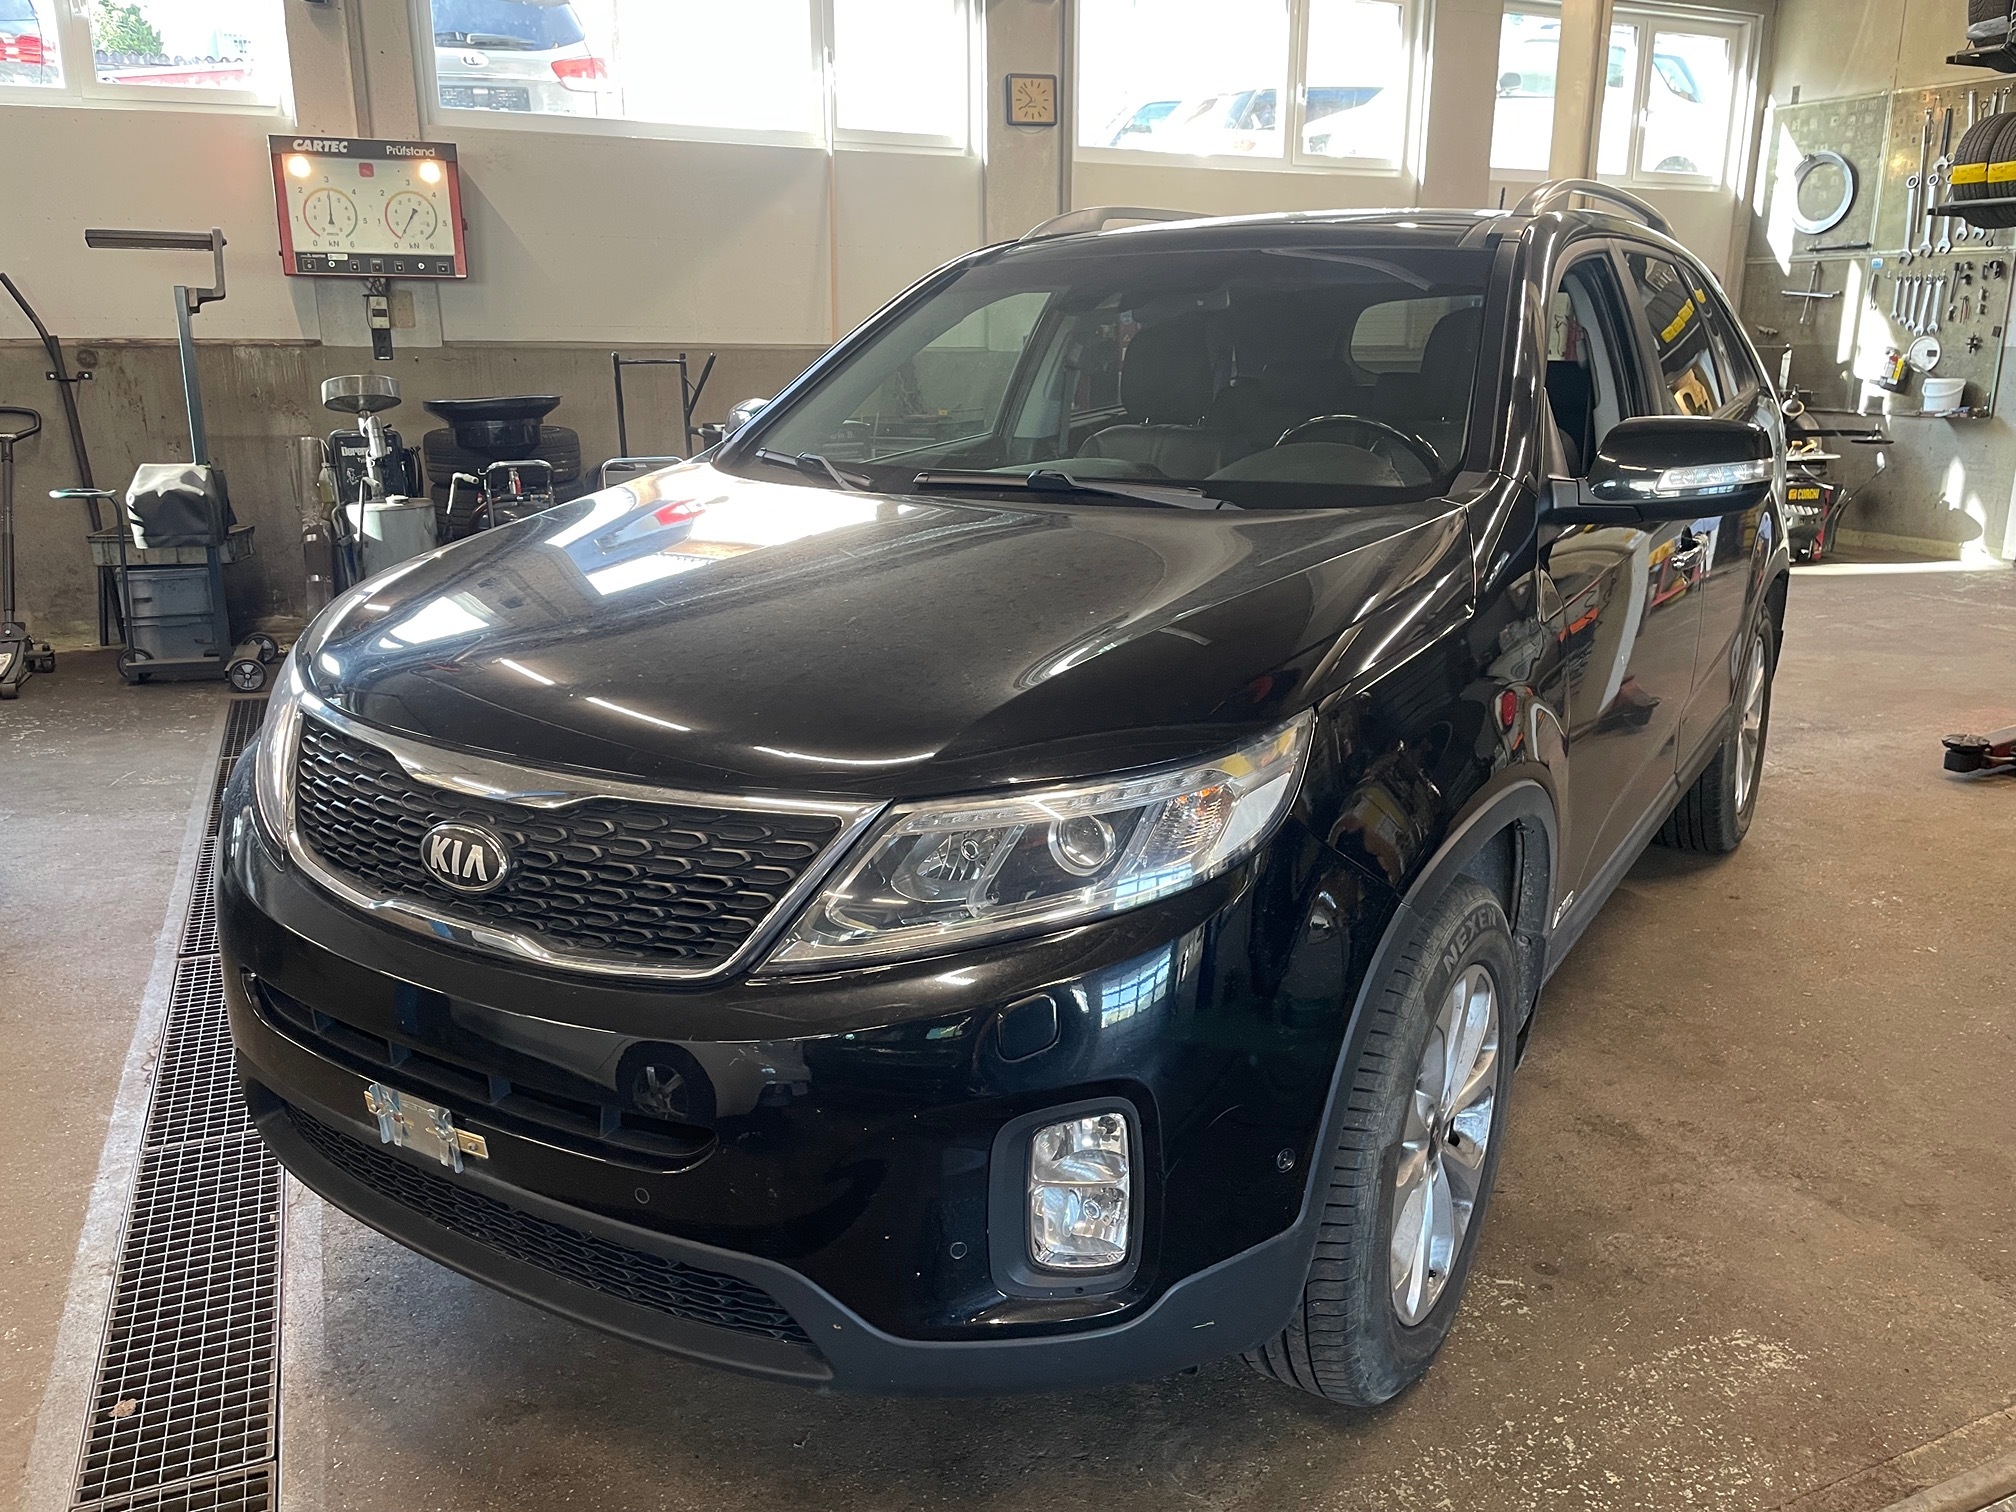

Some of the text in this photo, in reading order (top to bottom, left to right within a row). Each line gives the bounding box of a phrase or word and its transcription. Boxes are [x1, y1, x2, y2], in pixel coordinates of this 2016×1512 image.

[292, 139, 348, 153] CARTEC
[386, 145, 436, 157] Prüfstand
[430, 834, 488, 882] KIA
[1443, 907, 1497, 975] NEXEN
